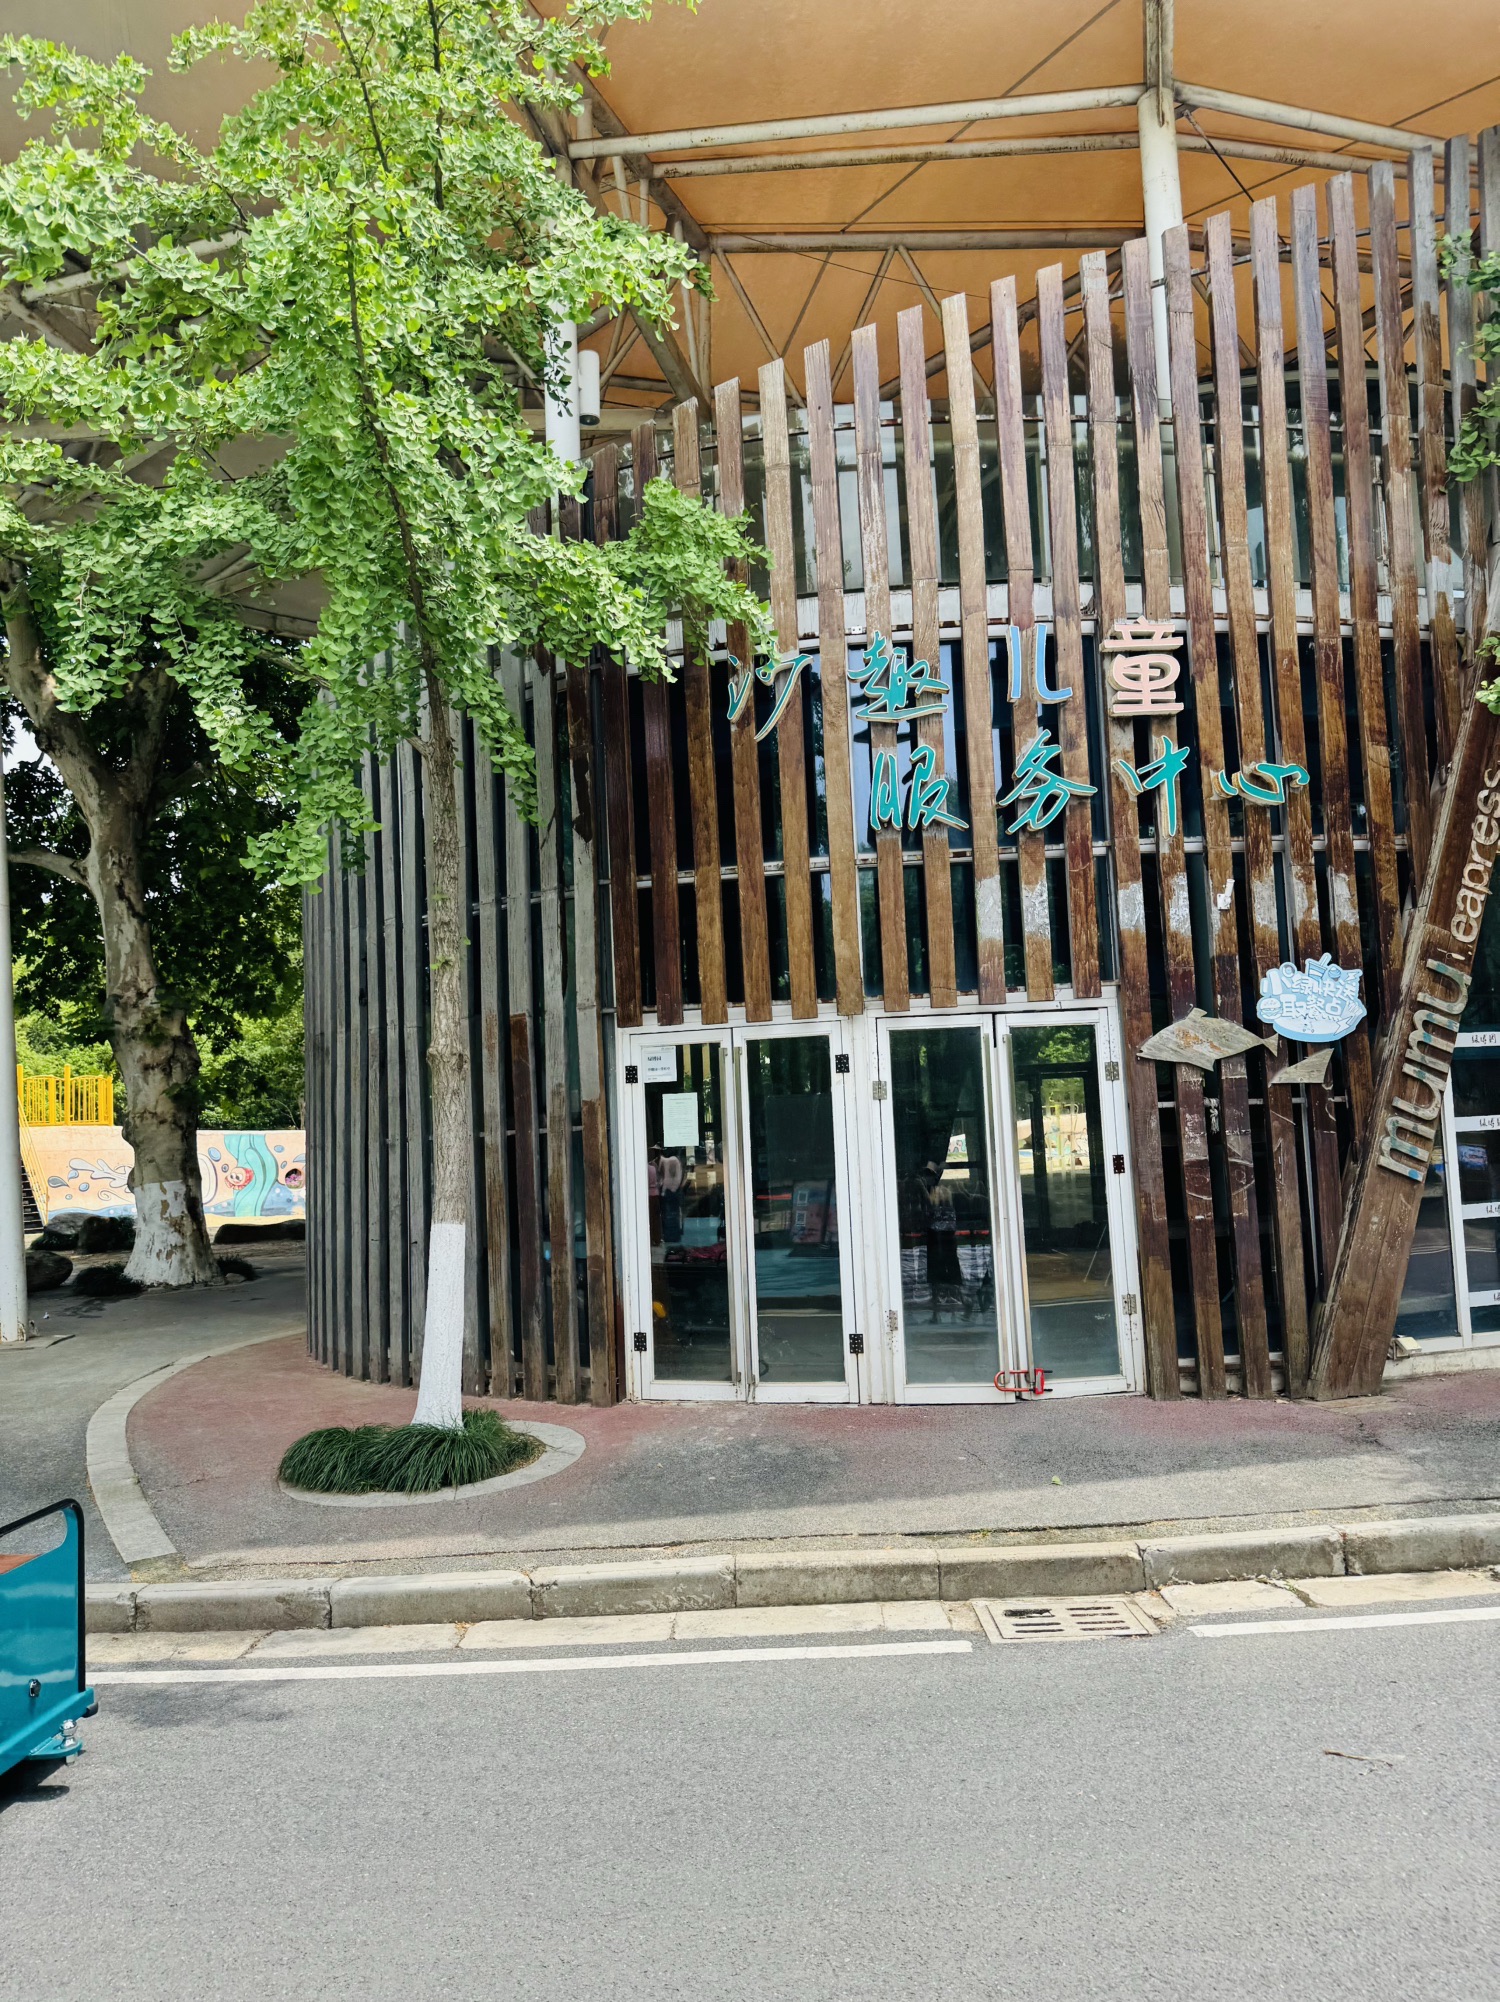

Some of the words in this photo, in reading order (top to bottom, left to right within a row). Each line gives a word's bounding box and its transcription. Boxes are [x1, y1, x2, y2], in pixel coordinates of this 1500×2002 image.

[870, 729, 1310, 838] 服务中心
[1261, 970, 1357, 1001] 小绿快送
[1280, 994, 1342, 1020] 取餐点
[1377, 958, 1473, 1183] mumu
